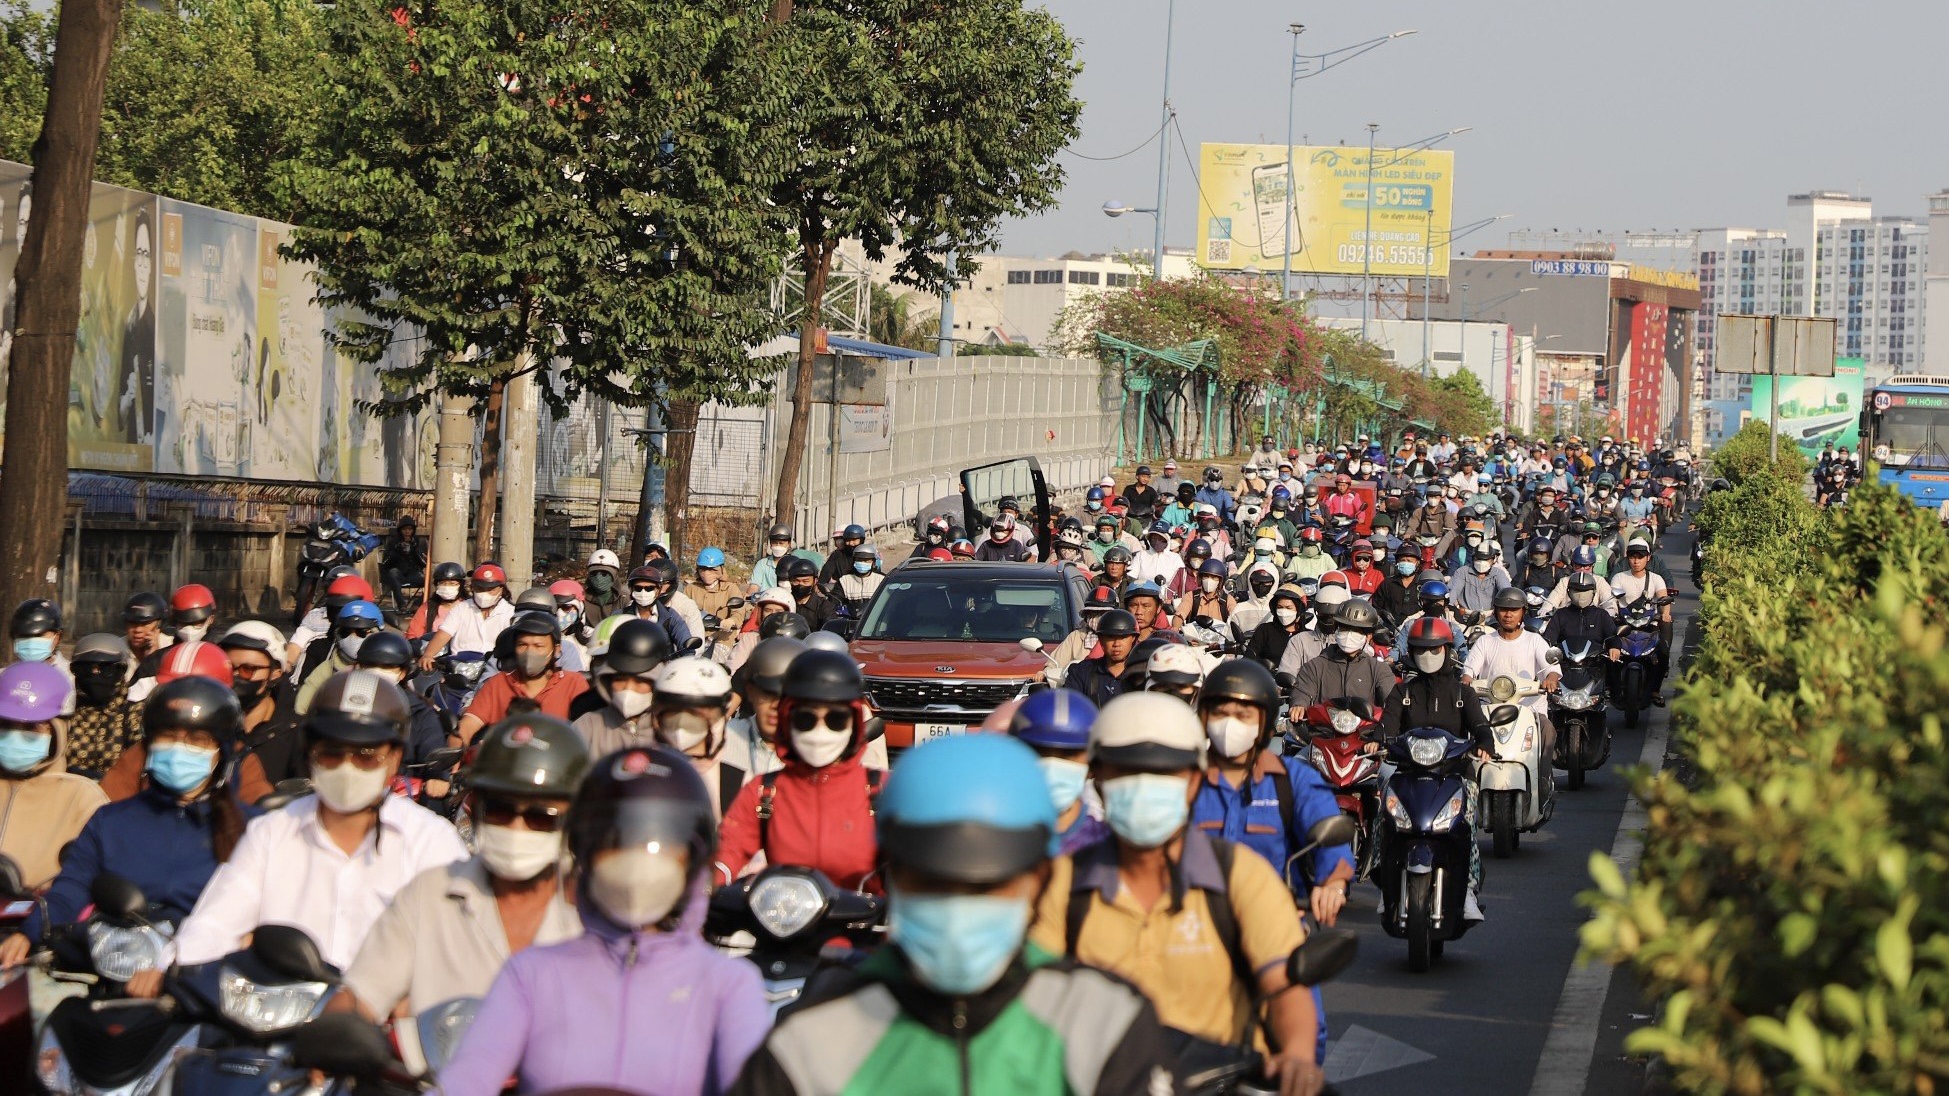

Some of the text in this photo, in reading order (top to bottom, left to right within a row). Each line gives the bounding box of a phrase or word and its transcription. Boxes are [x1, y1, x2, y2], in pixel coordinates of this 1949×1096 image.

[1334, 168, 1356, 178] MÀN
[1384, 170, 1400, 179] LED
[1403, 170, 1422, 180] SIÊU
[1425, 171, 1442, 181] ĐẸP
[1375, 187, 1401, 206] 50
[1534, 261, 1607, 275] 0903 88 98 00
[1876, 396, 1889, 406] 94
[1877, 447, 1888, 456] 94
[930, 725, 951, 737] 66A
